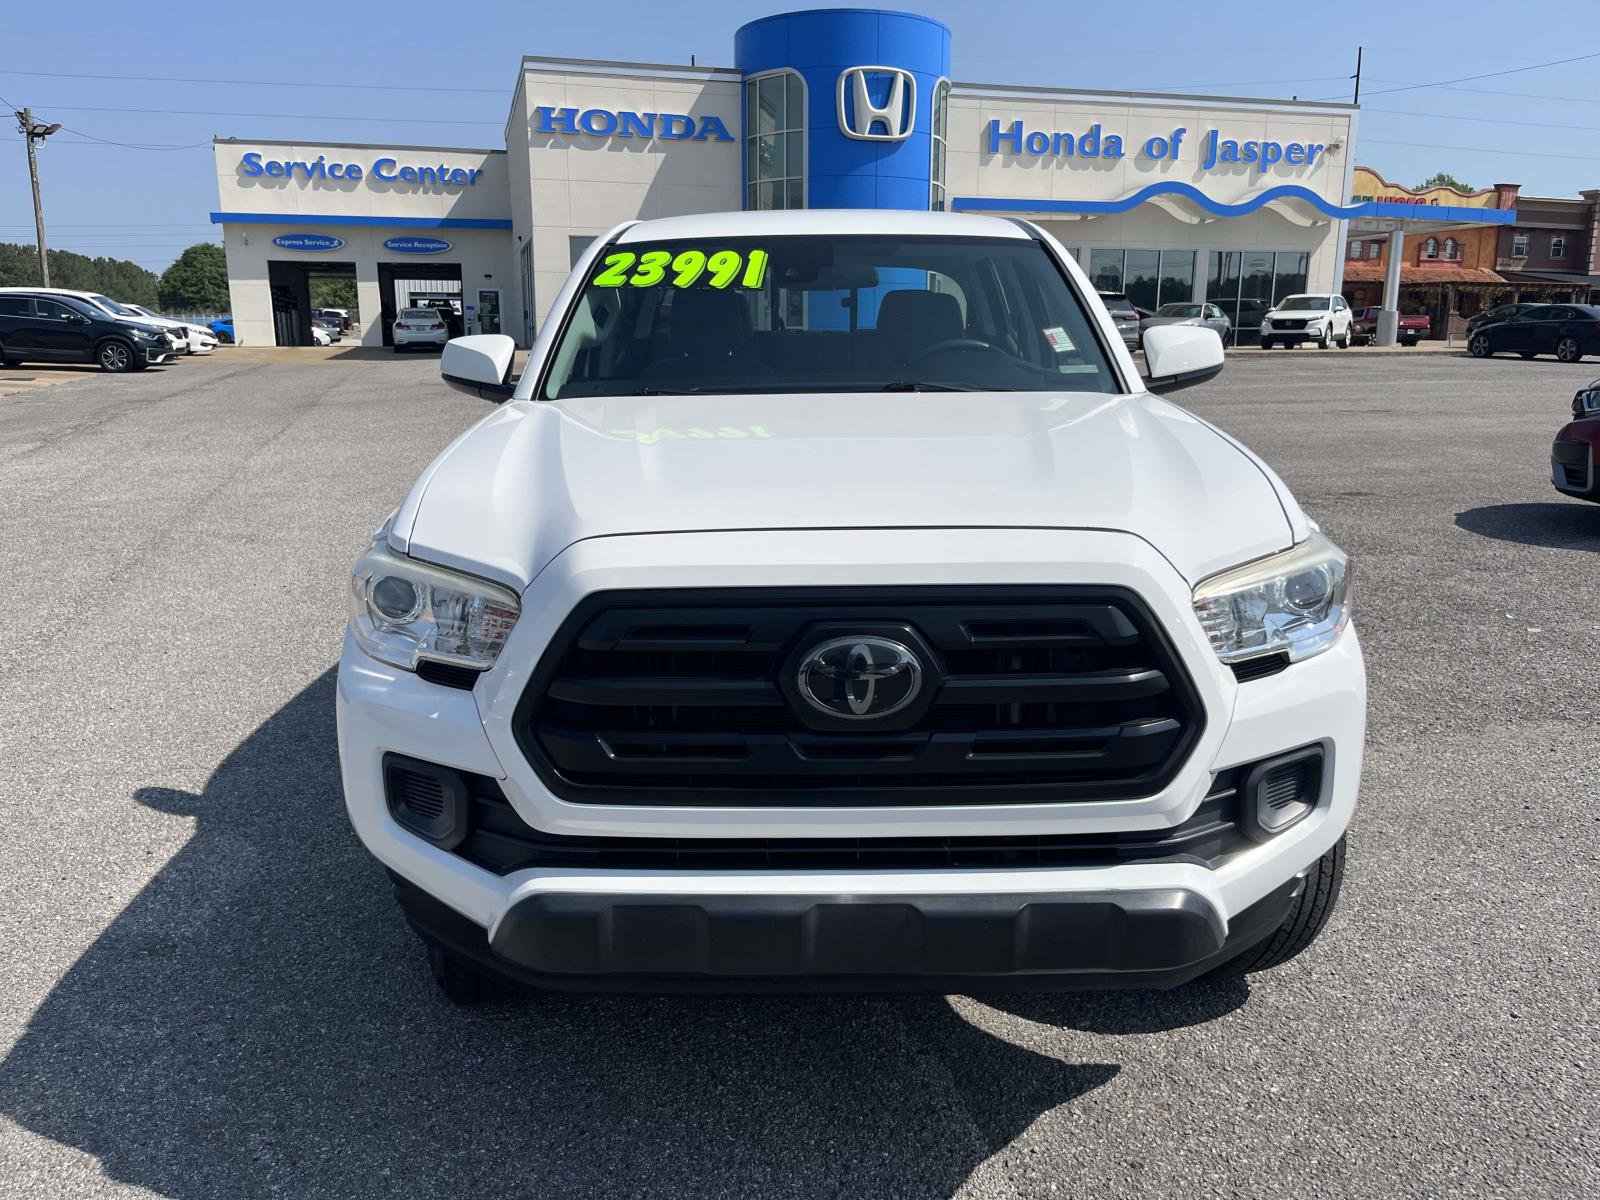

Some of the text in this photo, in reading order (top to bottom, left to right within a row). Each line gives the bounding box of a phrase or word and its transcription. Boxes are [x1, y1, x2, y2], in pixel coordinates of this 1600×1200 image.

[536, 105, 735, 143] HONDA
[989, 119, 1324, 174] Honda of Jasper
[242, 152, 483, 186] Service Center
[276, 238, 331, 248] Express Service
[387, 241, 448, 250] Service Reception
[593, 249, 768, 289] 23991
